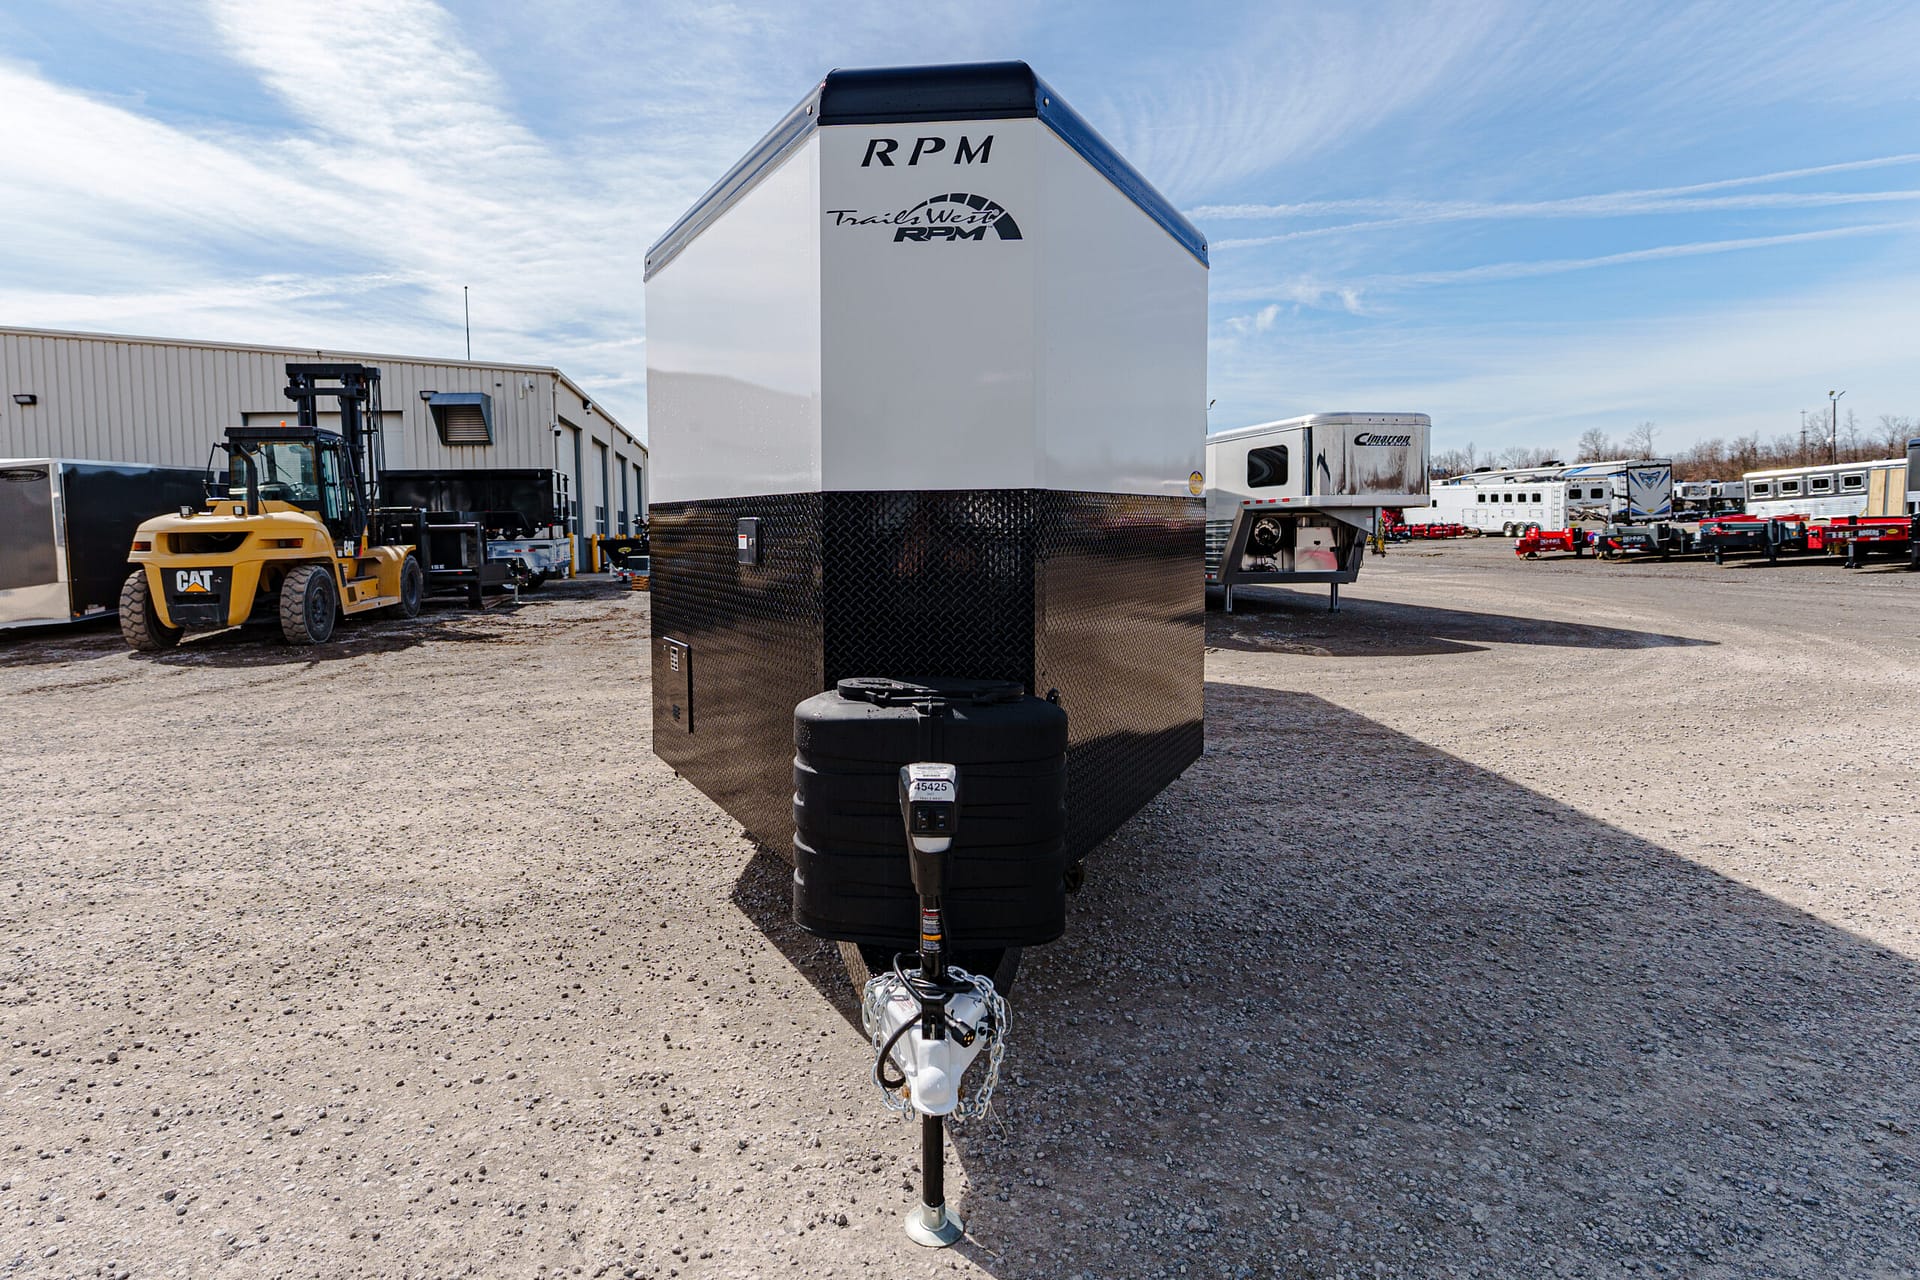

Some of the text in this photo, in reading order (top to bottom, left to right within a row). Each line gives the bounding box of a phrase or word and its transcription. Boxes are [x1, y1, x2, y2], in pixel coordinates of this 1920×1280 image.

[861, 135, 994, 167] RPM
[826, 208, 994, 226] Trails West
[893, 225, 988, 243] RPM
[1354, 432, 1411, 446] Cimarron
[344, 540, 355, 557] CAT
[176, 570, 213, 592] CAT
[914, 782, 948, 792] 45425
